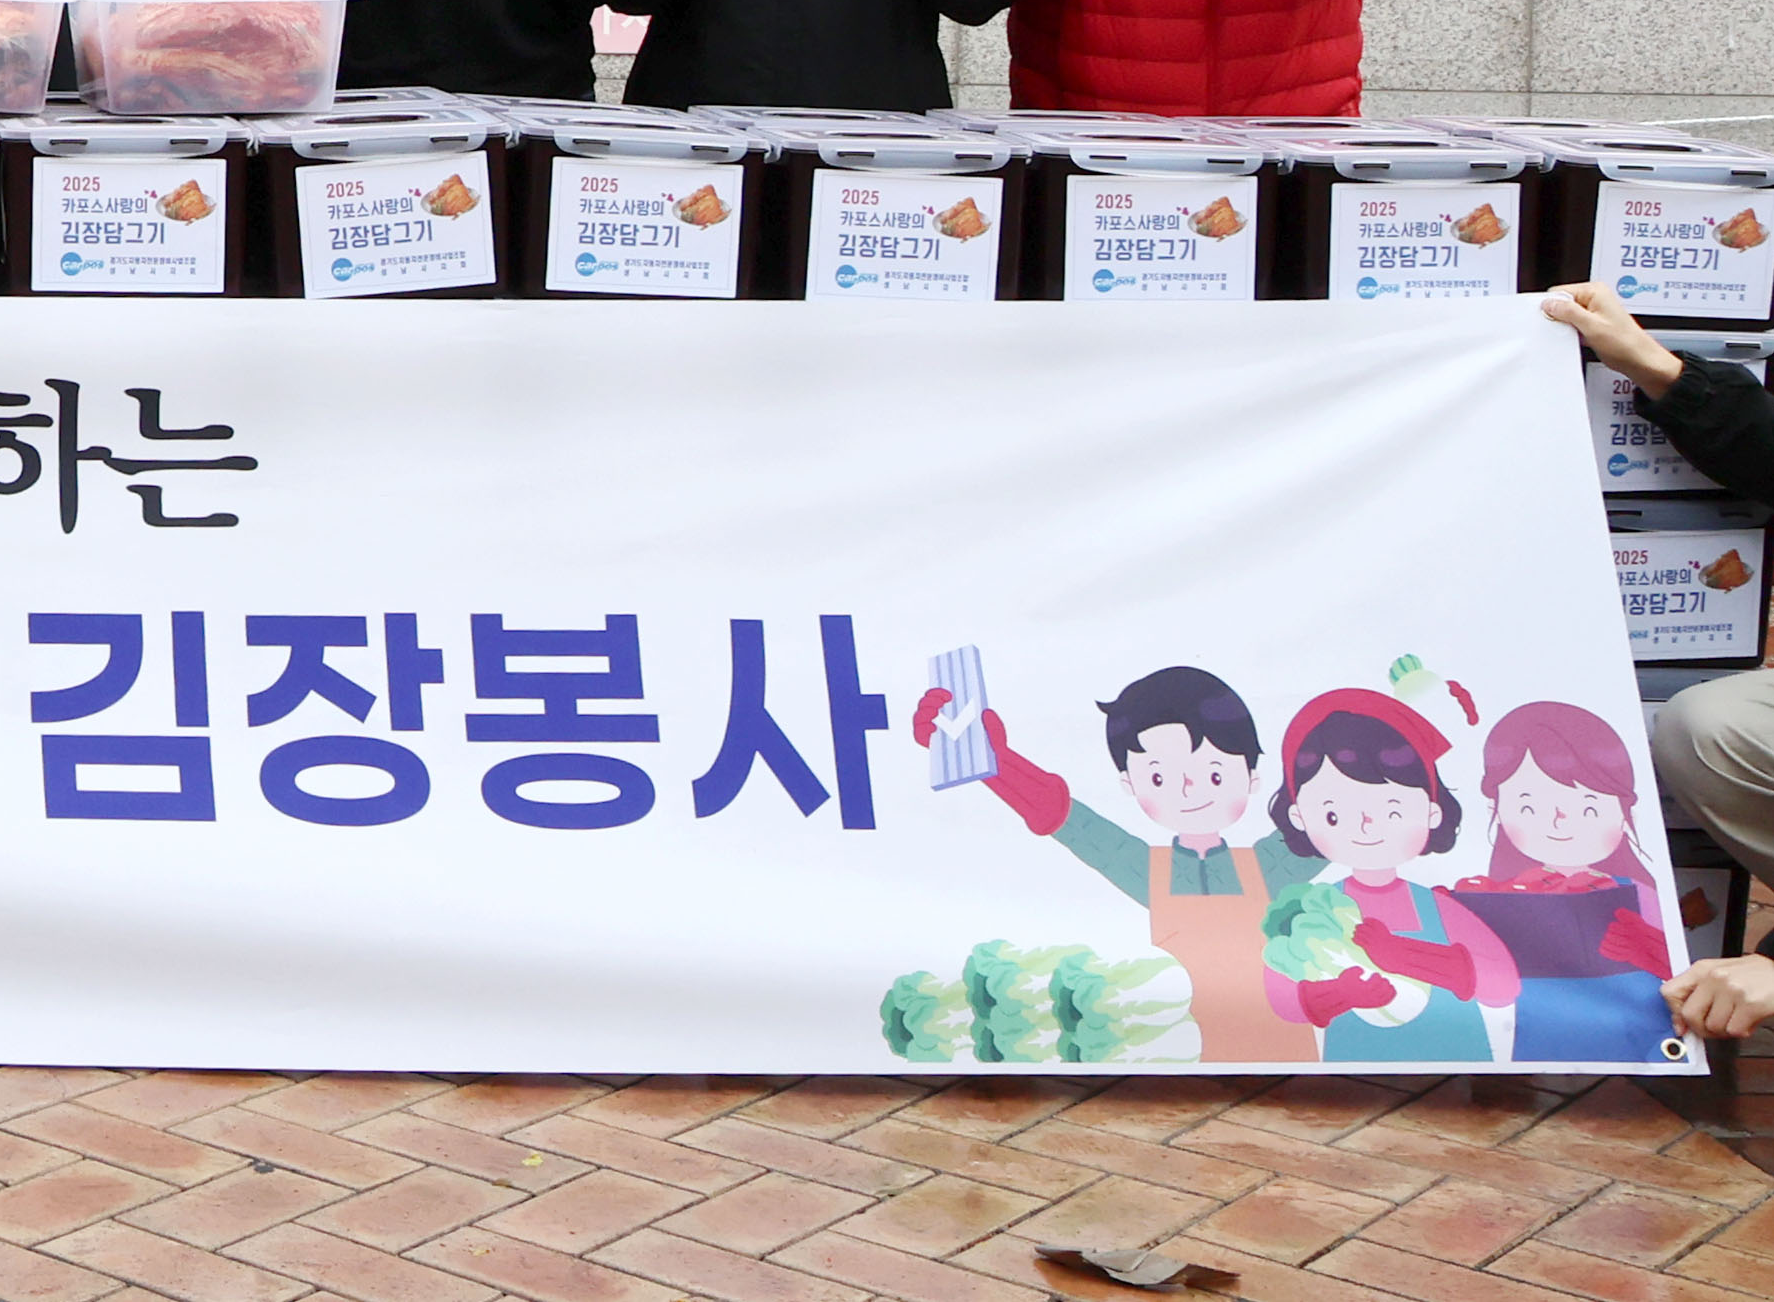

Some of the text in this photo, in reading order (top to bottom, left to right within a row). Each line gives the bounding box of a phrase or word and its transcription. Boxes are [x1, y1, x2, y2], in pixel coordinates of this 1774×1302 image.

[62, 176, 100, 192] 2025
[326, 180, 364, 199] 2025
[581, 176, 618, 193] 2025
[63, 197, 148, 214] 카포스사랑의
[842, 189, 879, 206] 2025
[1096, 193, 1133, 209] 2025
[328, 197, 413, 220] 카포스사랑의
[580, 199, 664, 217] 카포스사랑의
[1360, 201, 1397, 217] 2025
[1625, 201, 1662, 217] 2025
[841, 211, 924, 229] 카포스사랑의
[1096, 214, 1180, 231] 카포스사랑의
[61, 221, 165, 245] 김장담그기
[328, 219, 433, 251] 김장담그기
[578, 221, 680, 248] 김장담그기
[1360, 221, 1442, 238] 카포스사랑의
[1624, 223, 1705, 240] 카포스사랑의
[838, 233, 940, 261] 김장담그기
[1094, 238, 1197, 262] 김장담그기
[1358, 245, 1459, 269] 김장담그기
[1620, 244, 1720, 271] 김장담그기
[1612, 379, 1636, 395] 20
[1613, 549, 1649, 566] 2025
[27, 610, 890, 831] 김장봉사
